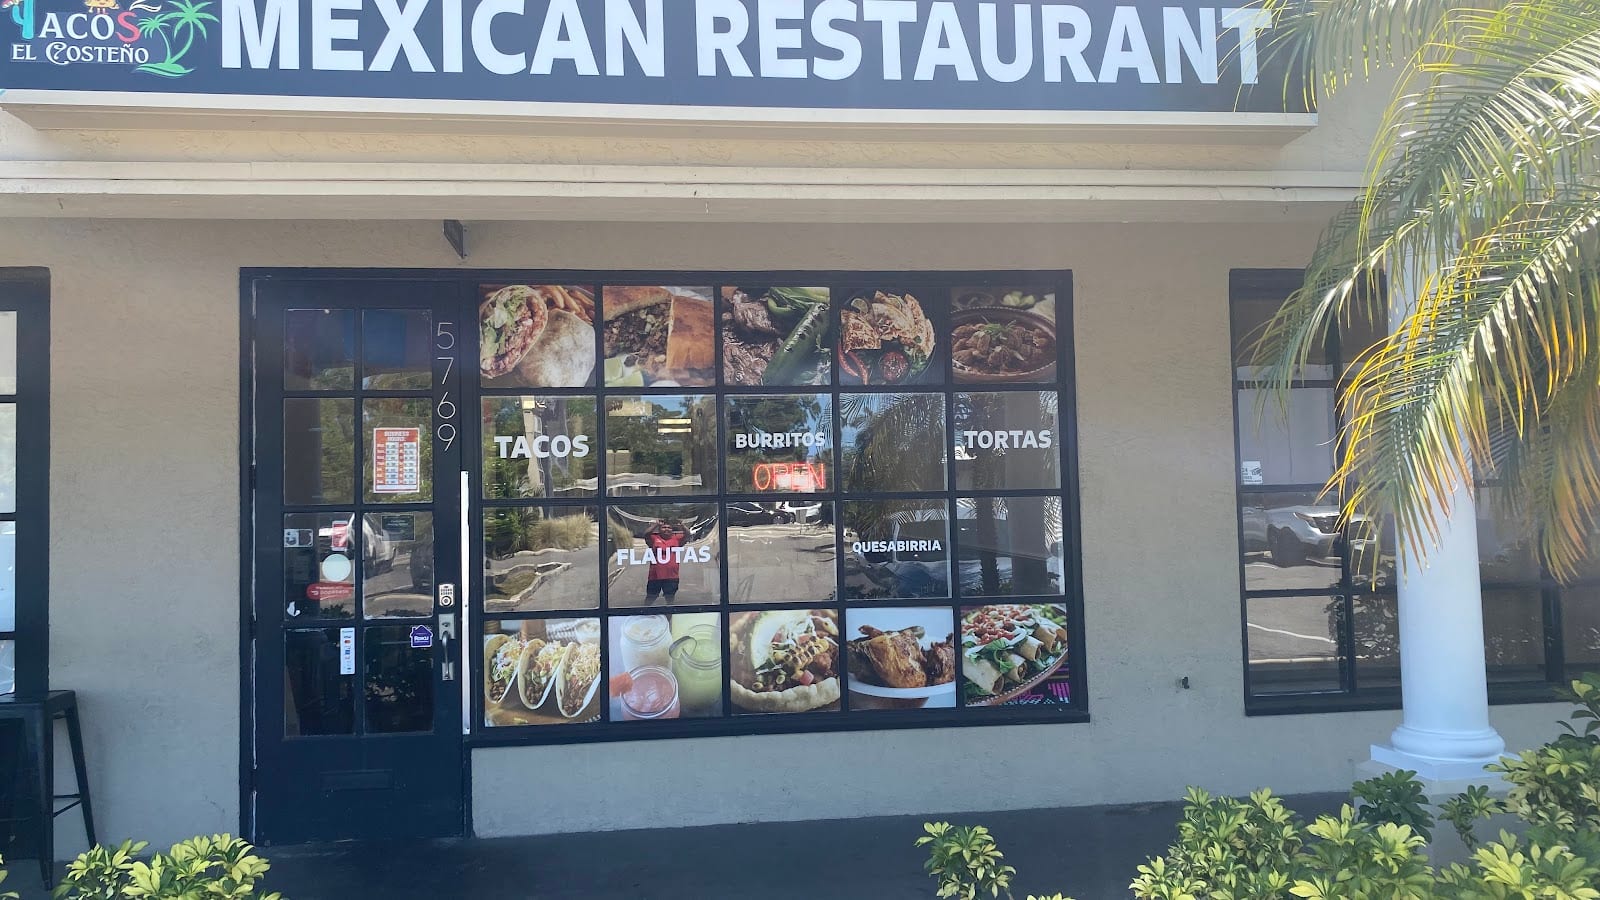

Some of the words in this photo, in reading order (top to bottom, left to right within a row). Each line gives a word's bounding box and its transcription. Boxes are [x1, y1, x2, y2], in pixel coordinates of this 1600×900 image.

[12, 44, 36, 60] EL
[221, 0, 665, 77] MEXICAN
[695, 0, 1273, 84] RESTAURANT
[494, 435, 589, 459] TACOS
[735, 431, 826, 449] BURRITOS
[963, 430, 1052, 449] TORTAS
[753, 461, 826, 491] OPEN
[616, 545, 711, 566] FLAUTAS
[852, 539, 942, 554] QUESABIRRIA
